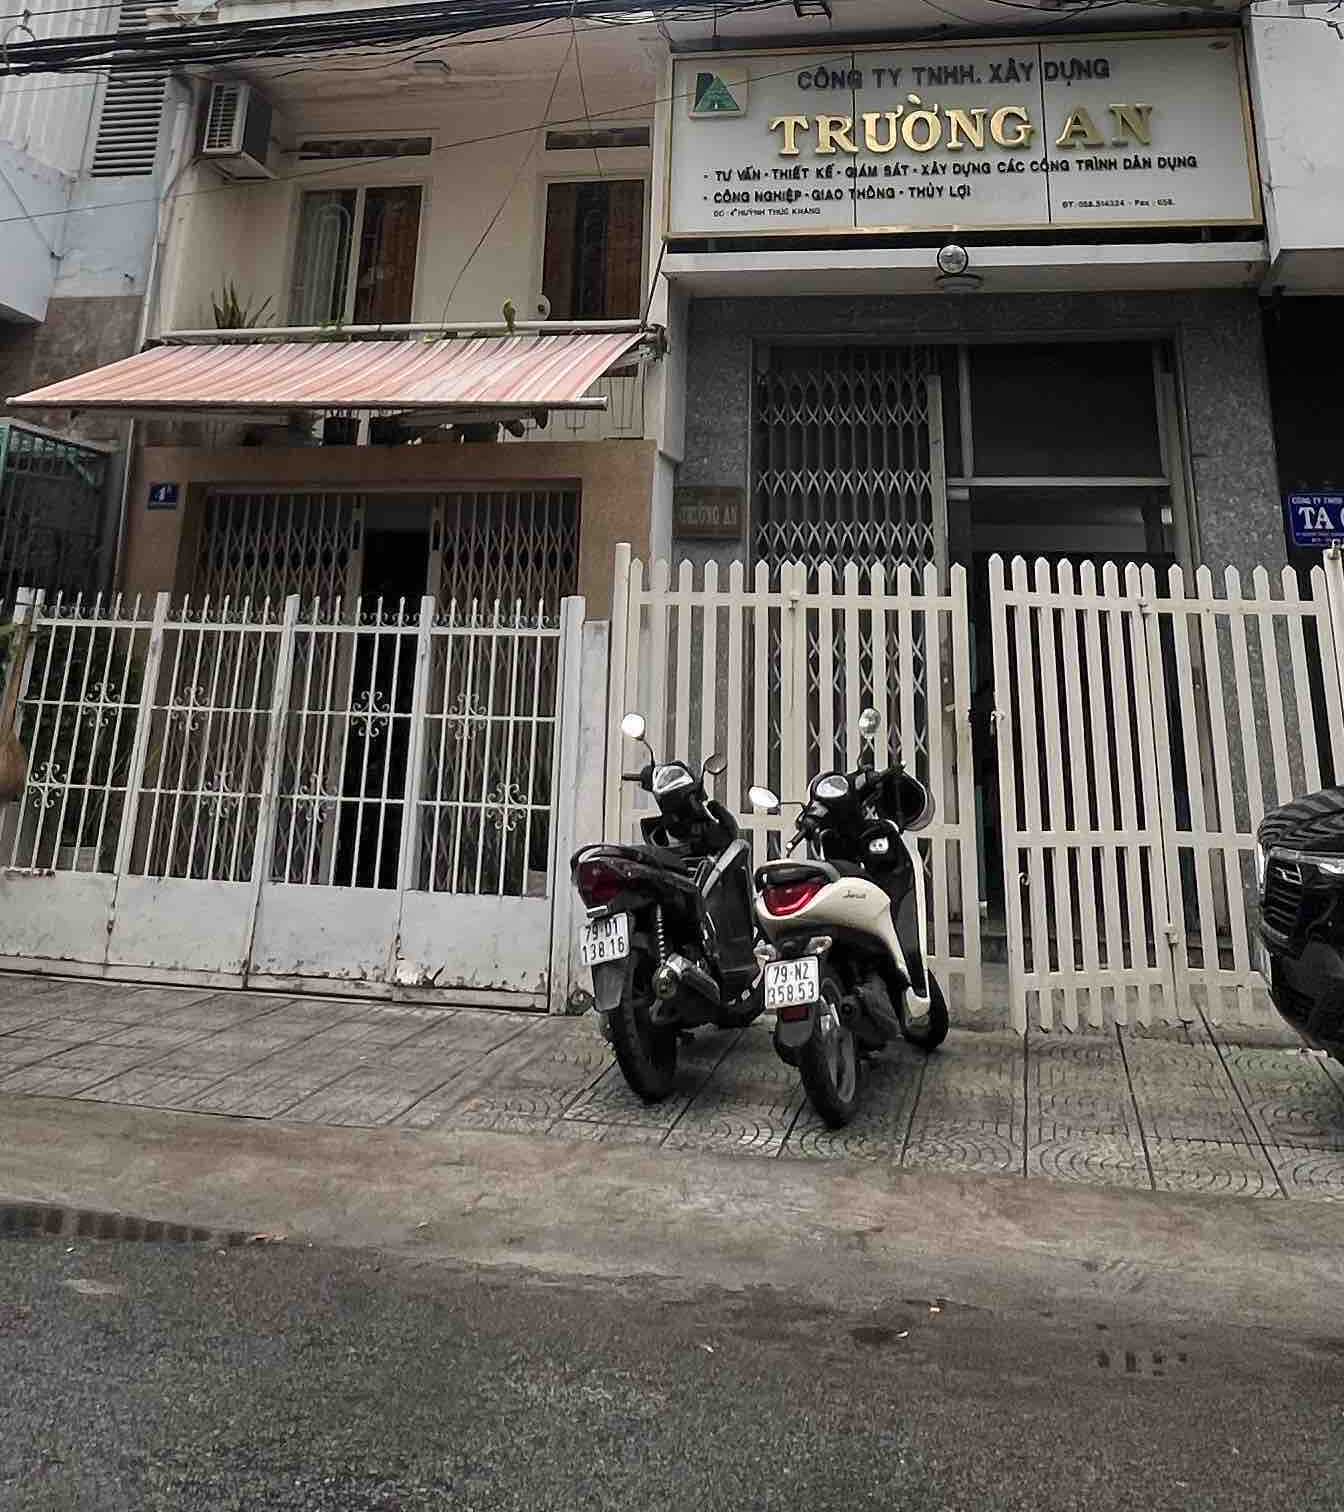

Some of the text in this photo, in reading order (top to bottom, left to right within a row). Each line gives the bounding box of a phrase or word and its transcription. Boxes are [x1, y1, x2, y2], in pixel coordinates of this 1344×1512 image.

[798, 66, 862, 89] CÔNG
[872, 68, 903, 87] TY
[989, 58, 1034, 84] XÂY
[1044, 58, 1111, 87] DỰNG
[769, 93, 1153, 156] TRƯỜNG AN
[772, 163, 809, 180] THIẾT
[815, 162, 834, 179] KẾ
[884, 160, 909, 177] SÁT
[921, 159, 947, 176] XÂY
[997, 157, 1025, 174] CÁC
[1030, 157, 1070, 173] CÔNG
[1076, 155, 1118, 170] TRÌNH
[1123, 154, 1152, 170] DÂN
[714, 187, 750, 204] CÔNG
[755, 186, 803, 205] NGHIỆP
[812, 187, 844, 201] GIAO
[850, 184, 896, 200] THÔNG
[949, 184, 972, 200] LỢI
[1297, 506, 1335, 530] TA
